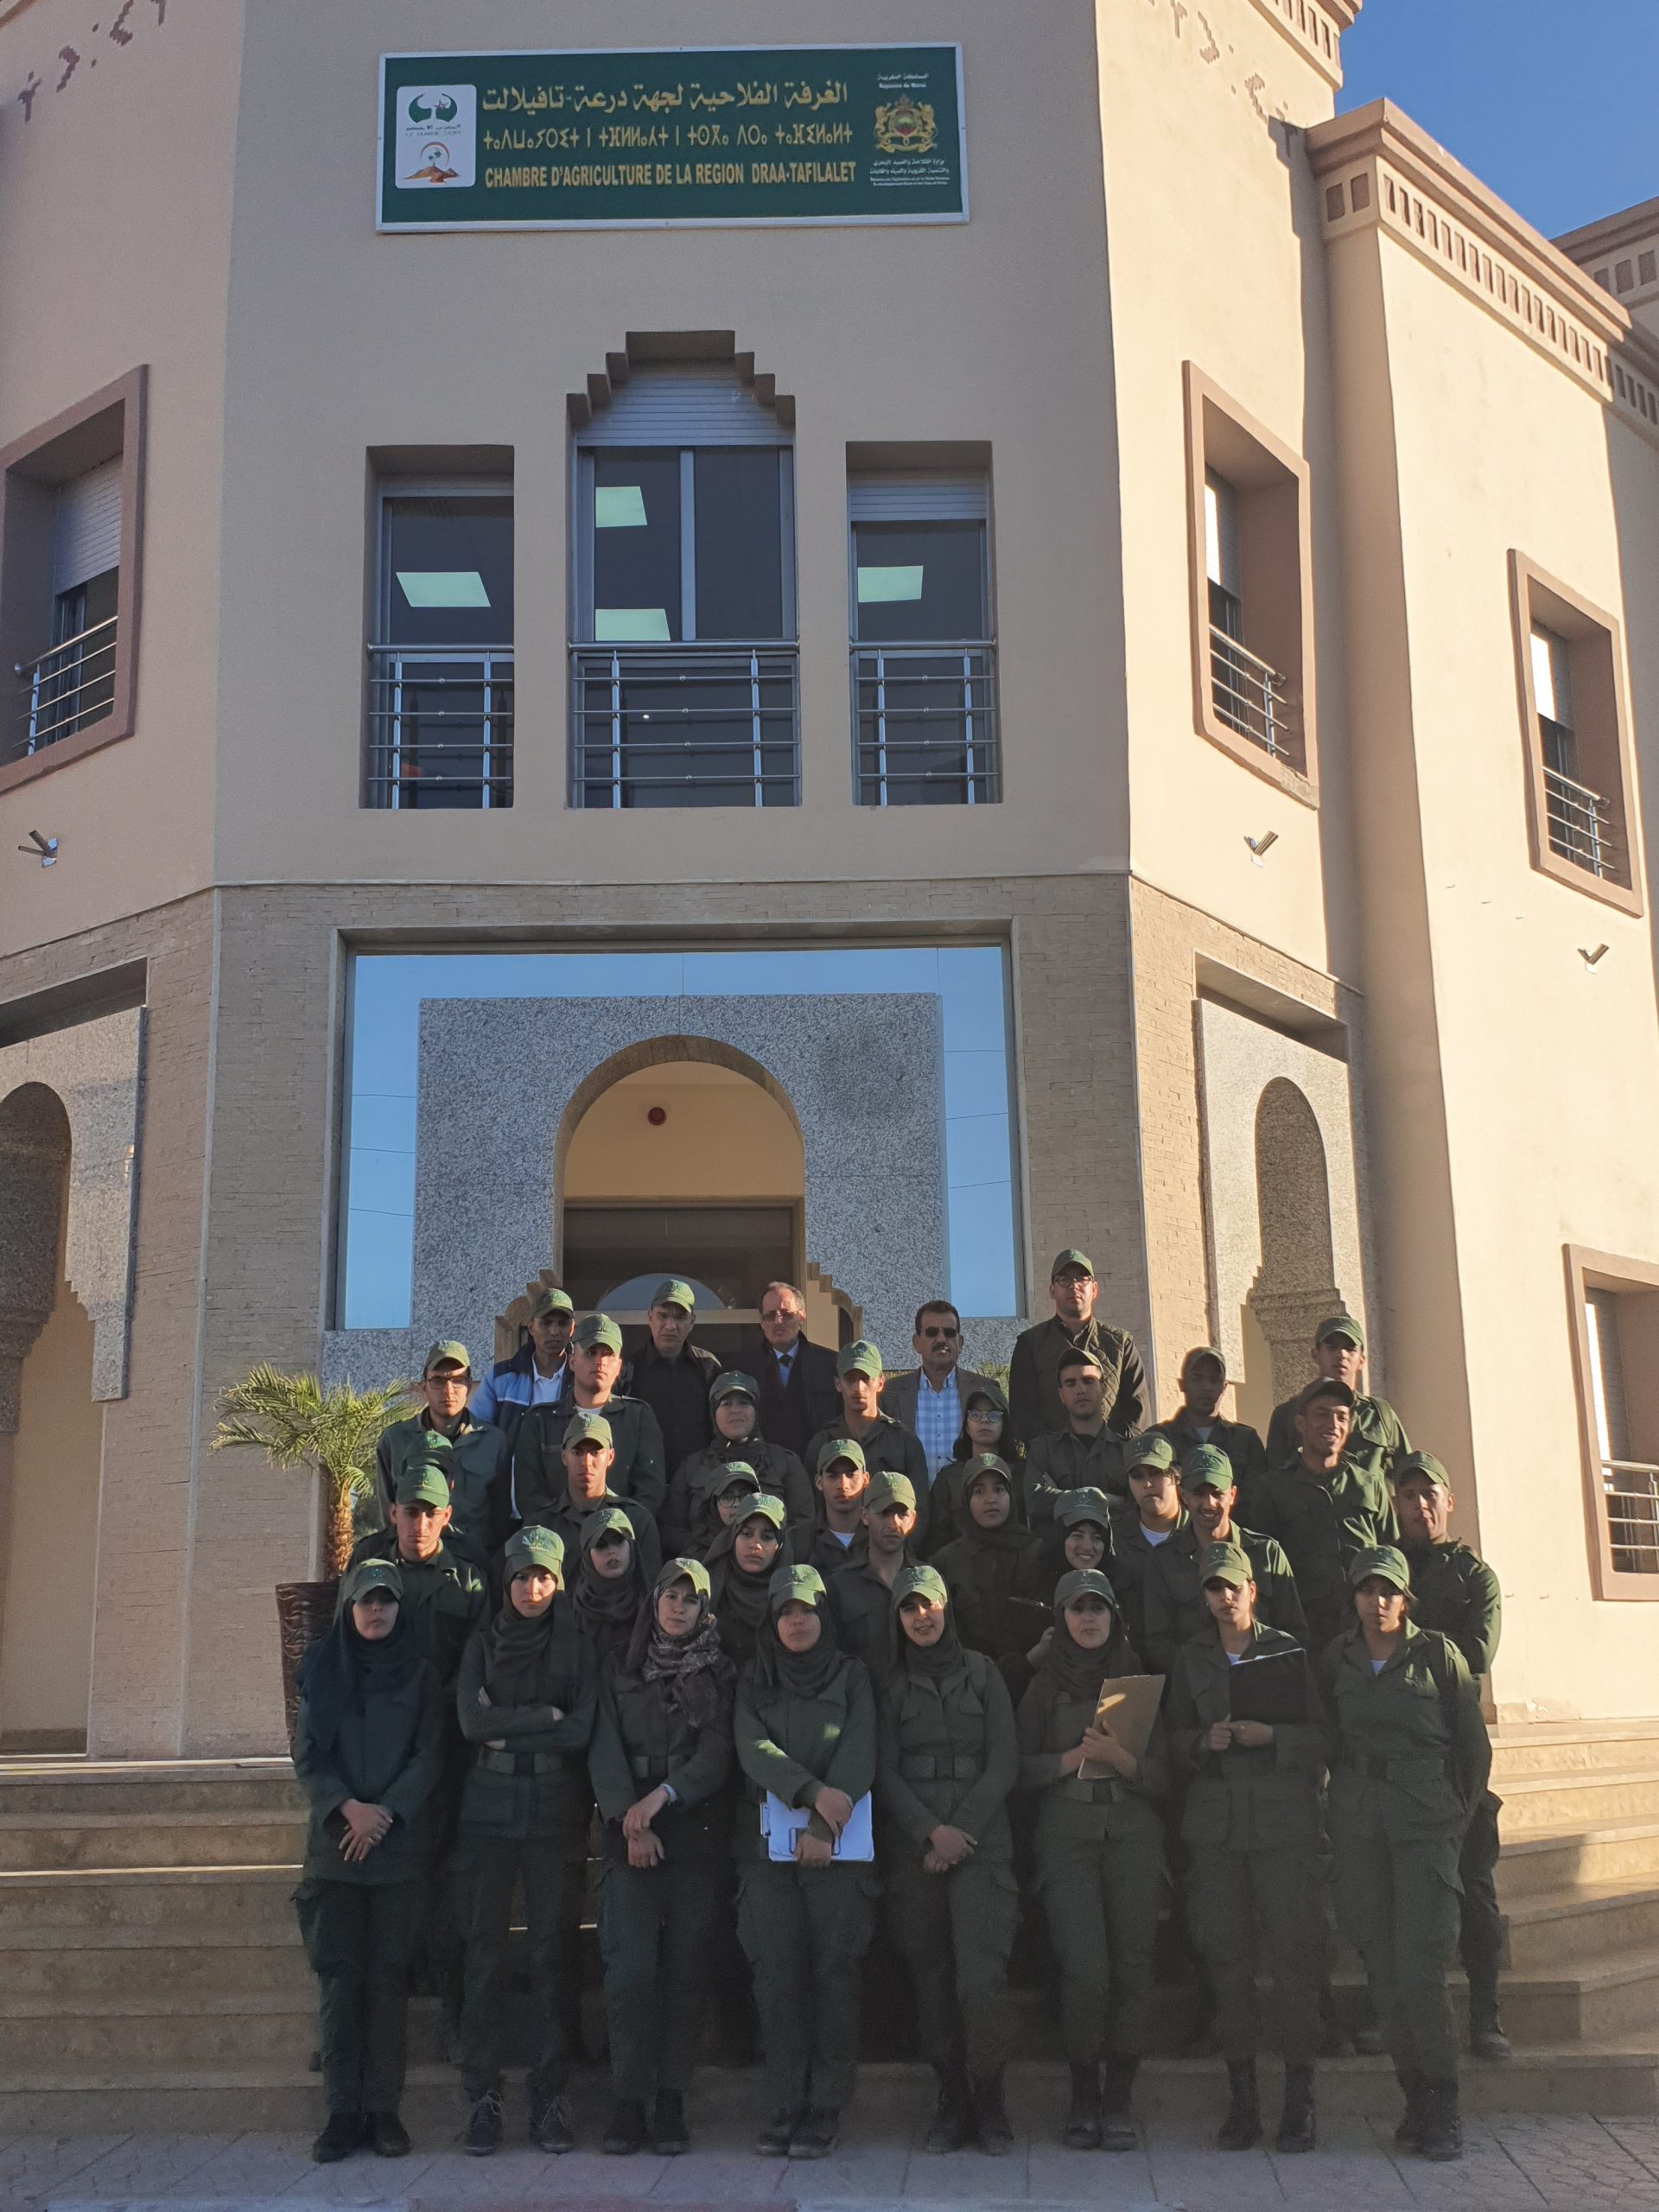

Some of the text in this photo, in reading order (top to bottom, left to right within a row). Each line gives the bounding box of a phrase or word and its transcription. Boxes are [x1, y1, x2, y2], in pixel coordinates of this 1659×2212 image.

[633, 84, 684, 114] لجهة
[690, 81, 778, 112] الفلاحية
[785, 80, 848, 111] الغرفة
[485, 161, 856, 188] CHAMBRE D'AGRICULTURE DE LA REGION DRAA-TAFILALET
